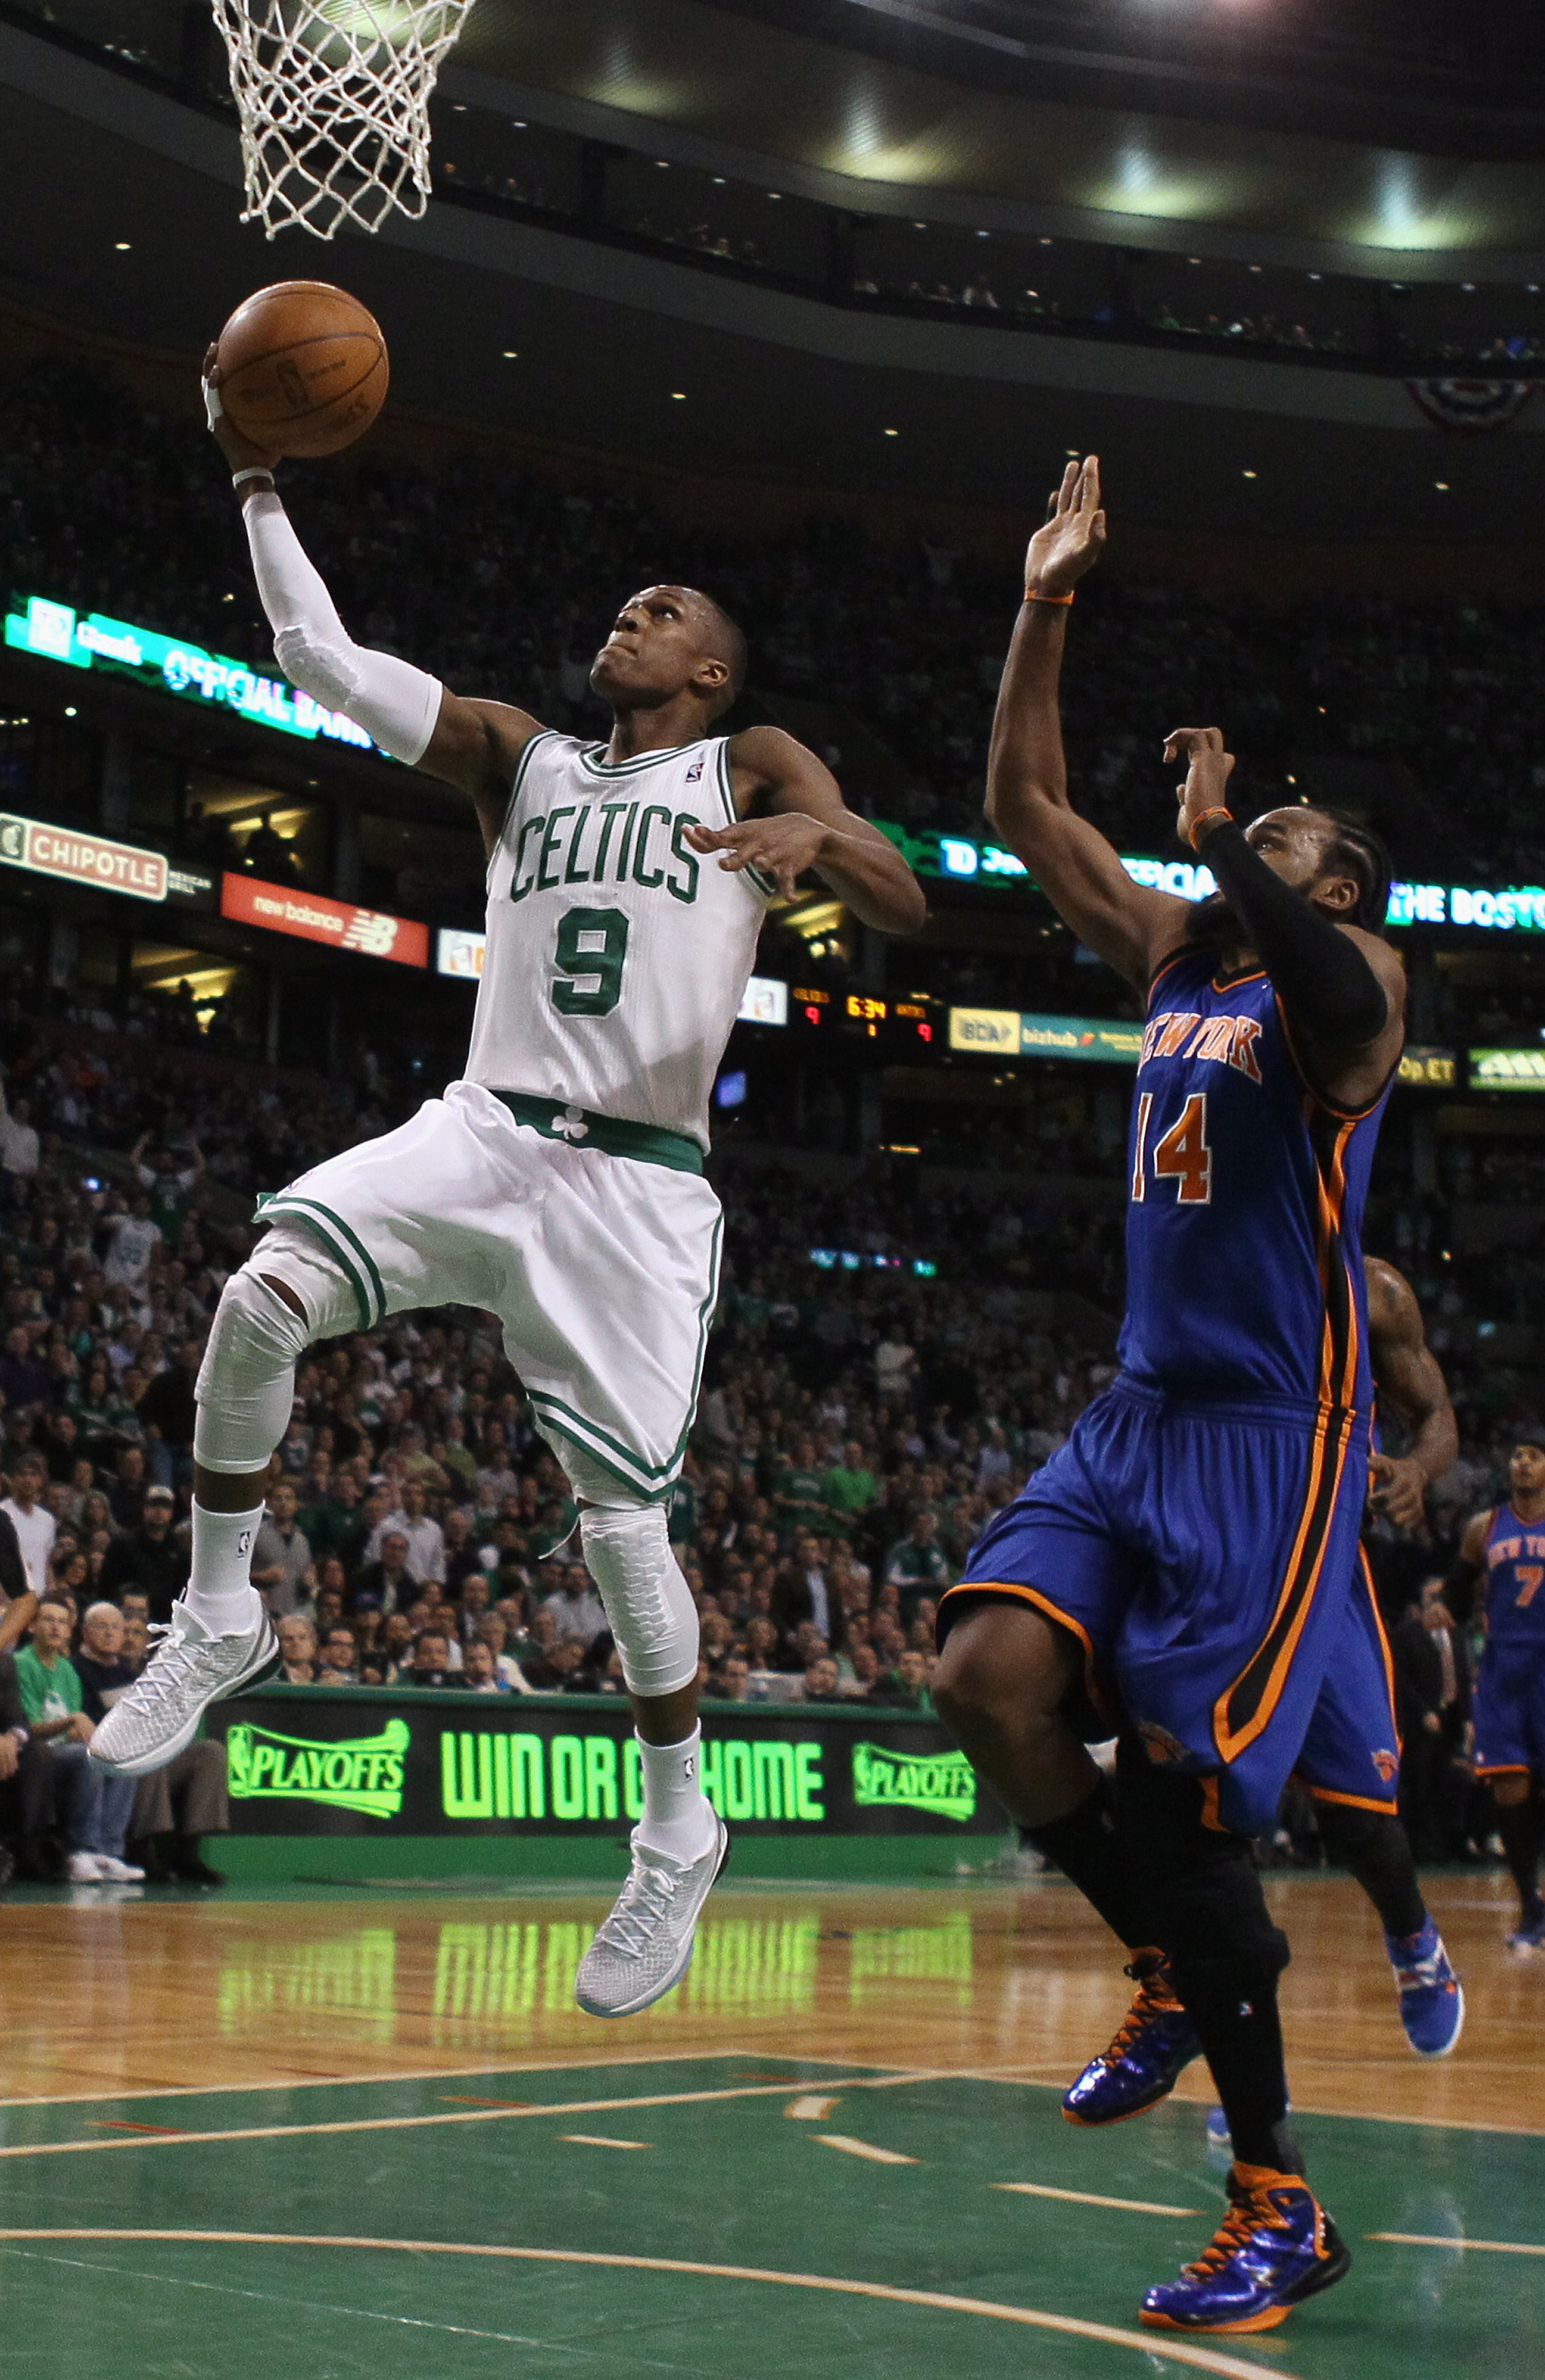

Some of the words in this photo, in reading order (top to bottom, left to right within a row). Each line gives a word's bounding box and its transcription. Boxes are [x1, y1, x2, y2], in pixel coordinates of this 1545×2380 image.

[163, 649, 291, 722] OFFICIAL
[34, 835, 159, 887] CHIPOTLE
[510, 801, 701, 904] CELTICS
[1119, 857, 1220, 903] FFICIA
[1389, 882, 1446, 923] THE
[253, 896, 284, 917] new
[285, 901, 345, 932] balance
[551, 908, 630, 1017] 9
[1137, 1012, 1202, 1077] EW
[1132, 1092, 1212, 1204] 14
[1514, 1565, 1544, 1607] 7
[252, 1744, 405, 1790] PLAYOFFS
[441, 1731, 544, 1818] WIN
[551, 1736, 618, 1819] OR
[623, 1738, 645, 1820] G
[699, 1740, 825, 1821] HOME
[870, 1758, 977, 1797] PLAYOFFS
